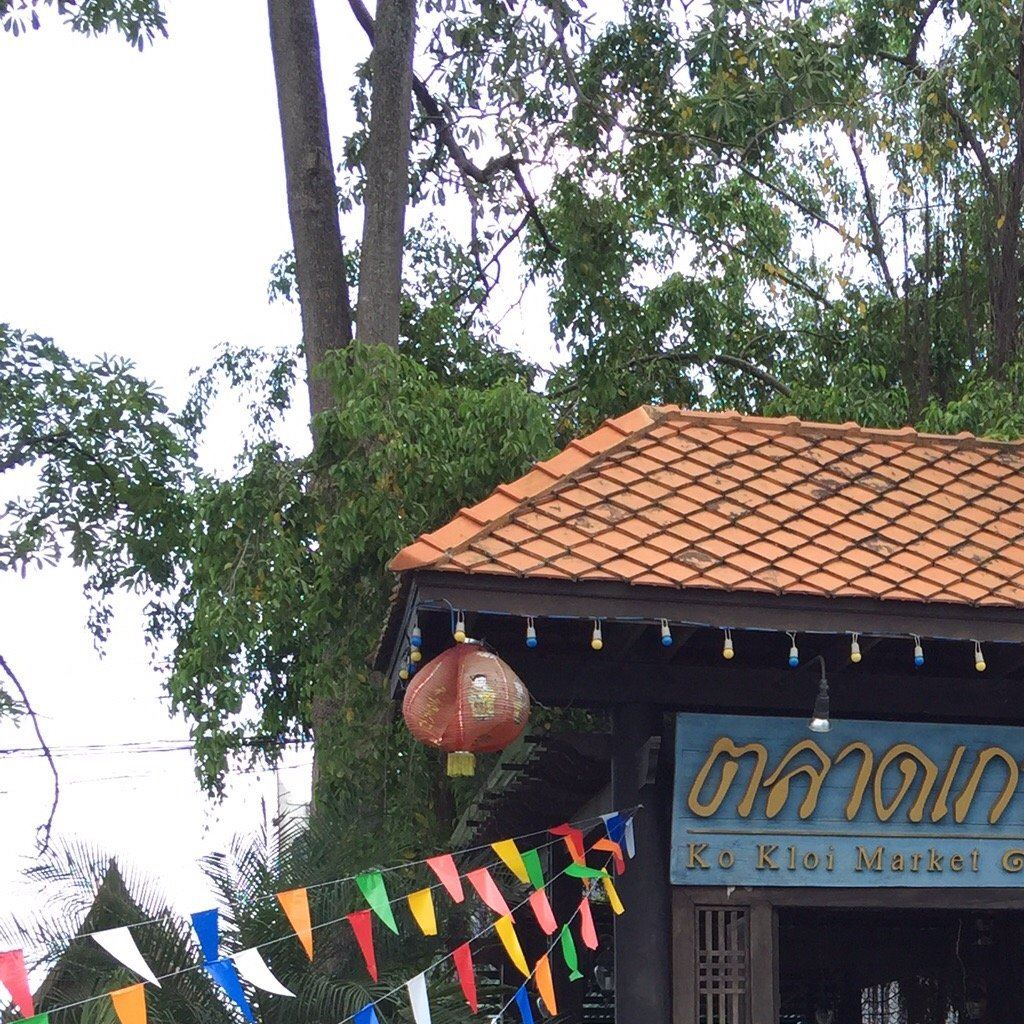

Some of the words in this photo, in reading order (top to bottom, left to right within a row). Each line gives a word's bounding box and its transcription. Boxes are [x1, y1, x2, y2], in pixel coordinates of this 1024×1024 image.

[686, 842, 735, 869] Ko
[755, 845, 835, 871] Kloi
[854, 846, 982, 873] Market
